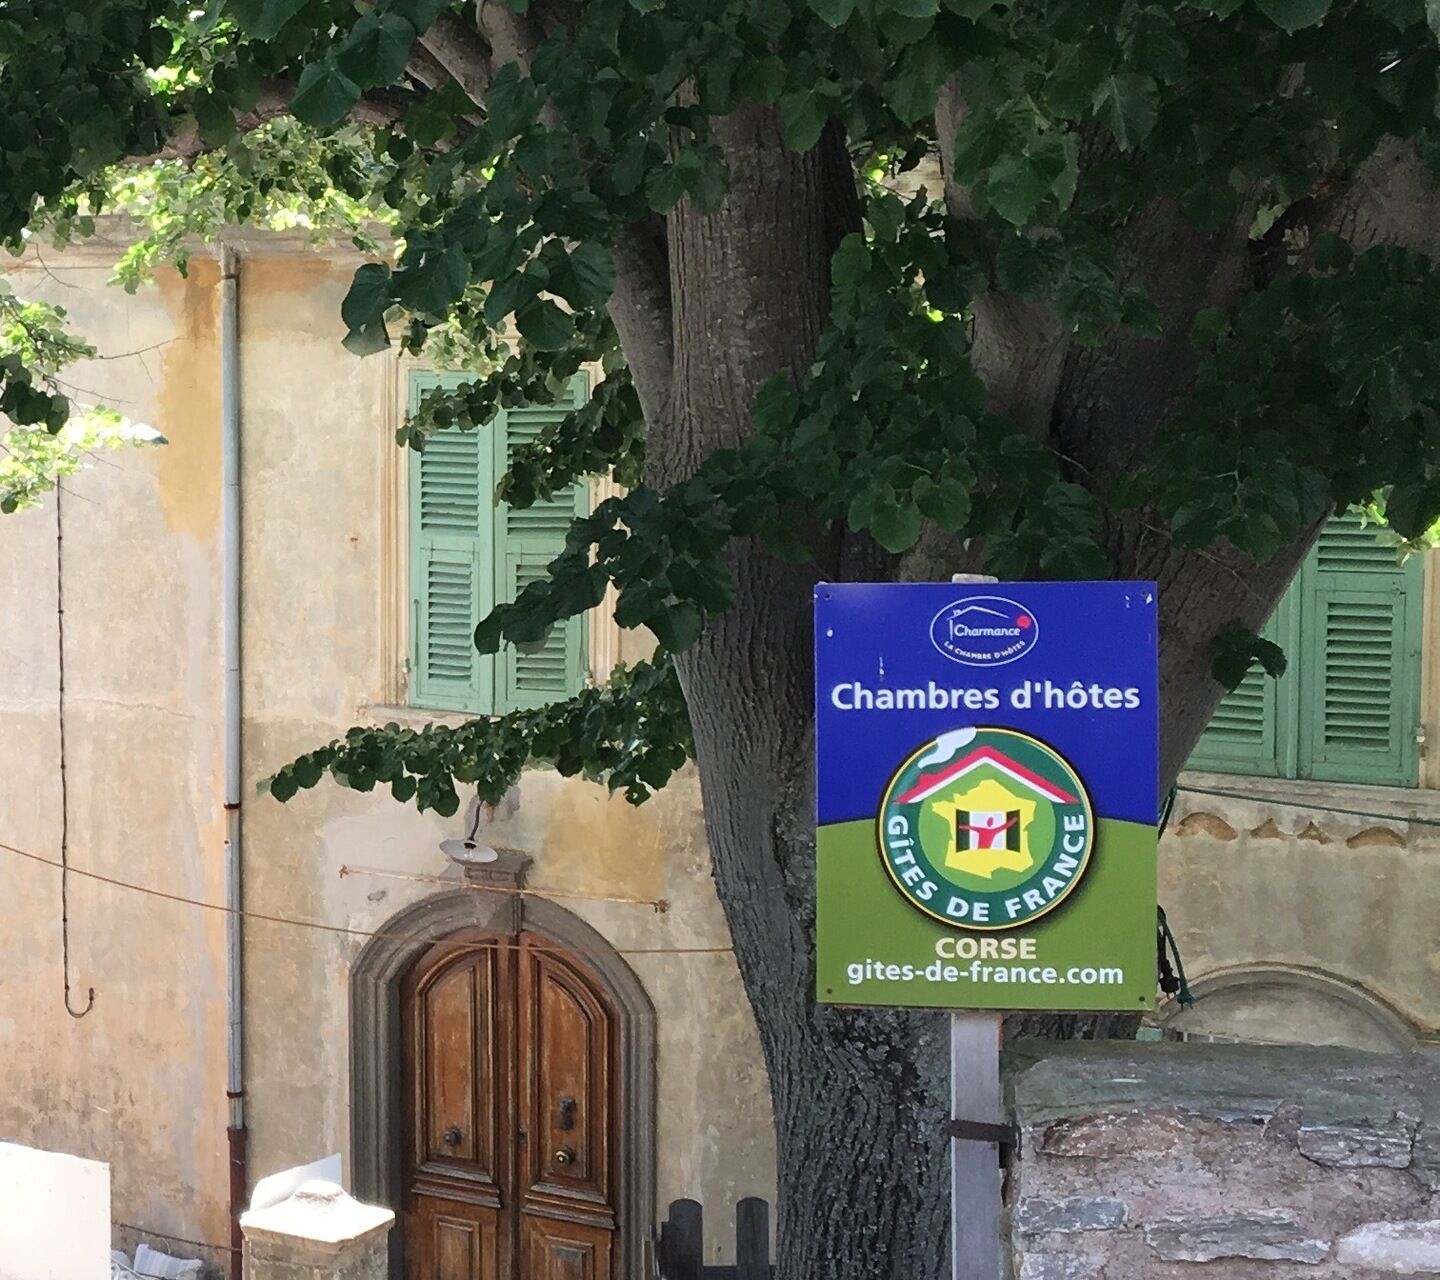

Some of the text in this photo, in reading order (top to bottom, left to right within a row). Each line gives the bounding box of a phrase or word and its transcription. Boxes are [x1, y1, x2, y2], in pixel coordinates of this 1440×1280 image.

[954, 624, 1021, 636] Charmance
[944, 640, 954, 650] LA
[955, 648, 992, 660] CHAMBRE
[831, 680, 1140, 710] Chambres d'hôtes
[888, 814, 1085, 922] GÎTES DE FRANCE
[935, 938, 1036, 960] CORSE
[847, 958, 1124, 985] gites-de-france.com
